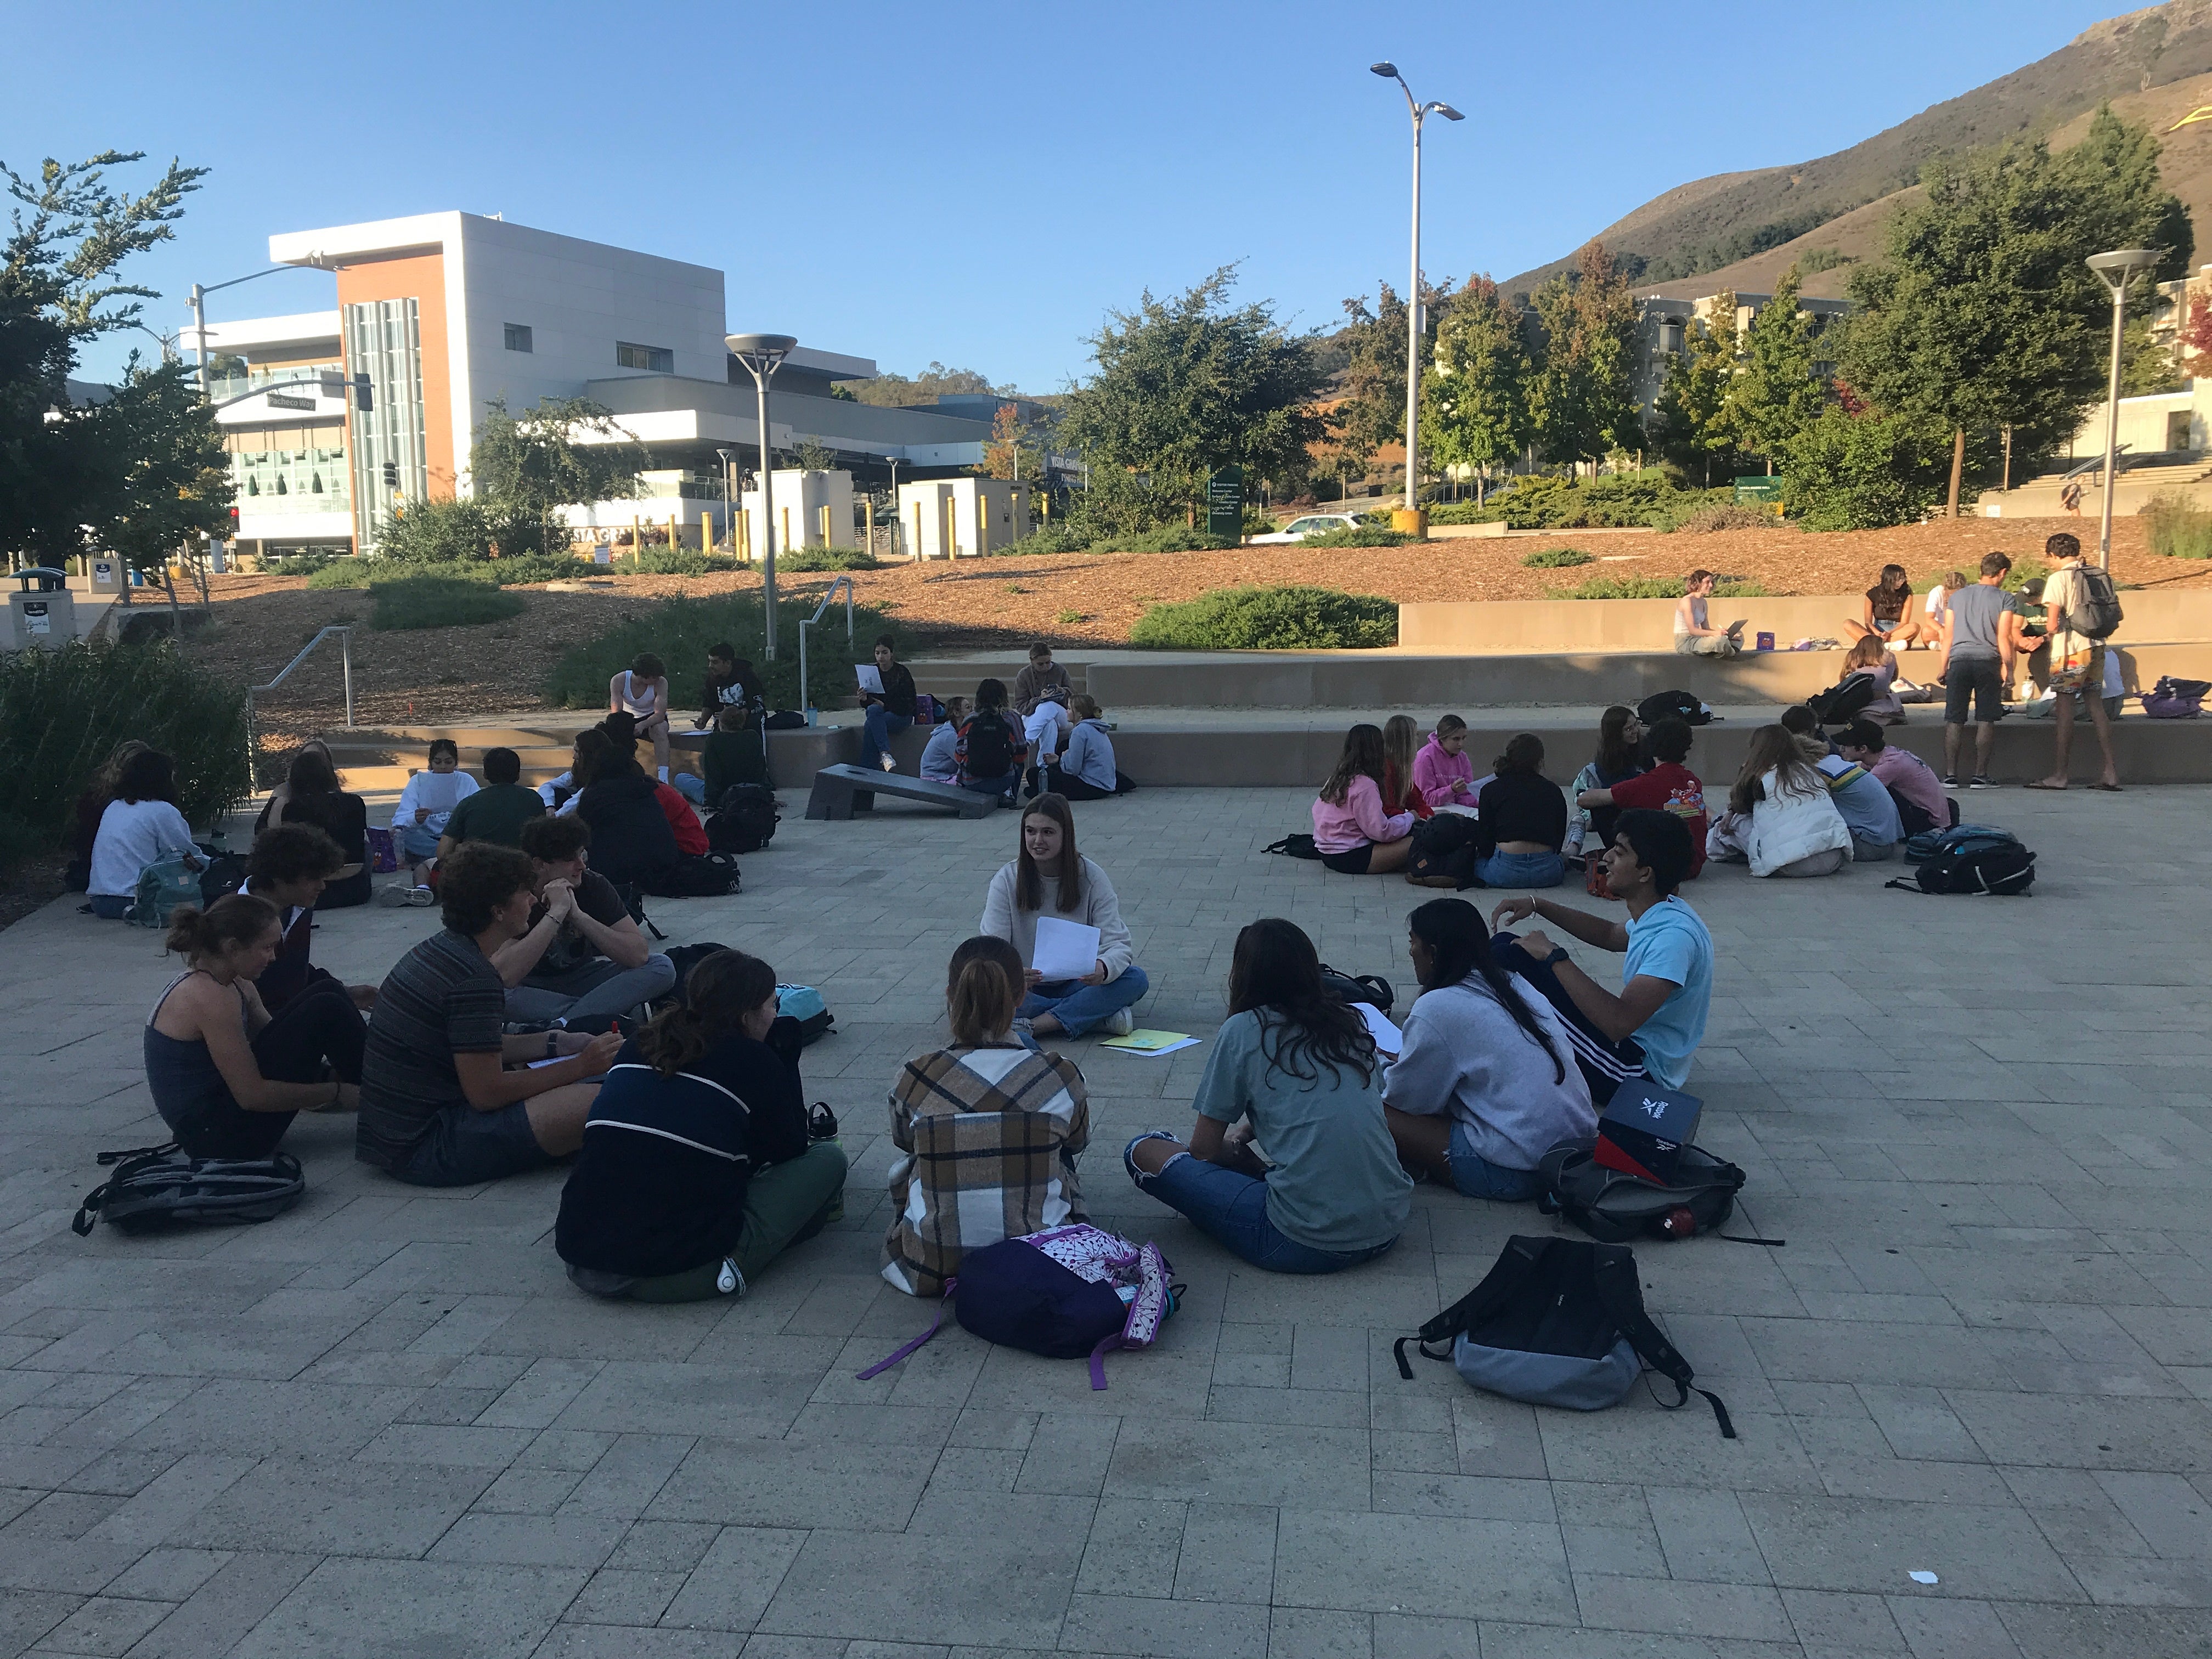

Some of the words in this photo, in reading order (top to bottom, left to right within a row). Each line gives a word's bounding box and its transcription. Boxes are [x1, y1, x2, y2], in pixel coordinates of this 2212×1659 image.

[269, 397, 298, 406] Pacheco
[299, 399, 314, 409] Way
[1050, 455, 1065, 469] VISTA
[1652, 1101, 1669, 1119] Reebok
[1656, 1138, 1677, 1149] Reebok
